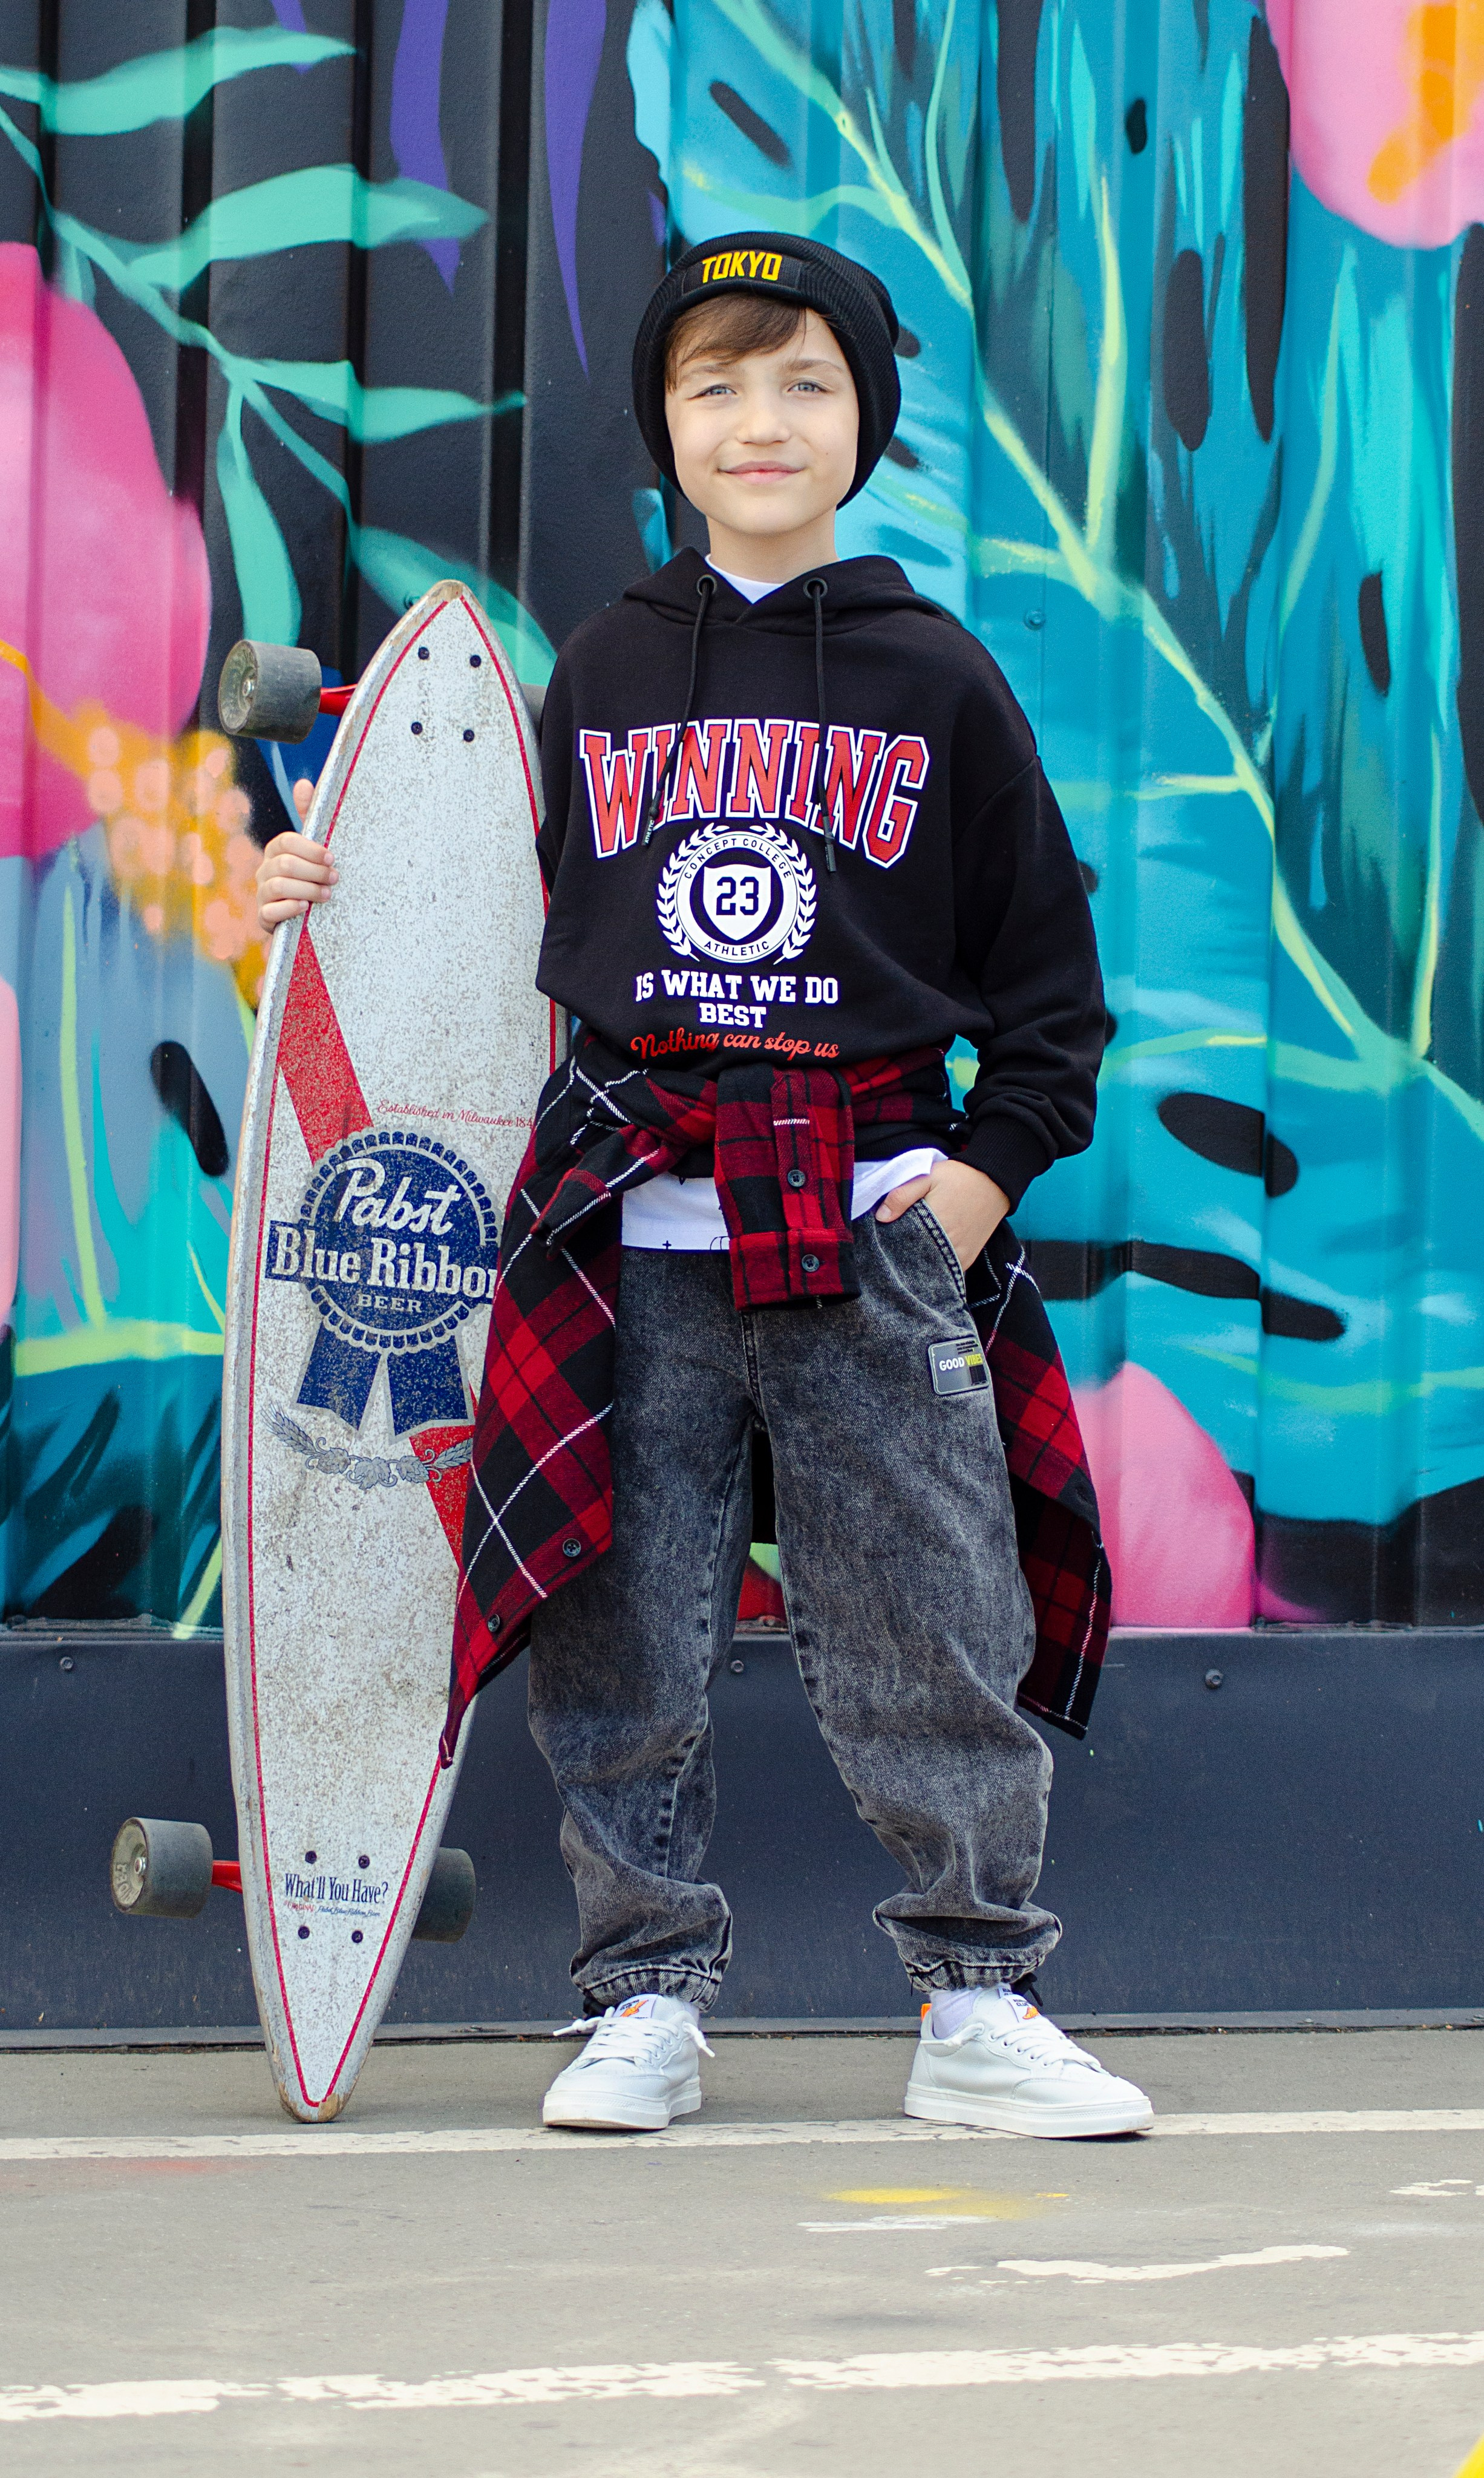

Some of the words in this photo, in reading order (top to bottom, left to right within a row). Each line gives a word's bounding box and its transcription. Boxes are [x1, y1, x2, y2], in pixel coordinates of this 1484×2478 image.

[702, 250, 782, 284] TOKYO
[580, 718, 930, 868] WINNING
[684, 838, 737, 879] CONCEPT
[743, 838, 791, 878] COLLEGE
[716, 876, 759, 916] 23
[704, 941, 770, 956] ATHLETIC
[635, 972, 654, 1002] IS
[661, 969, 742, 1000] WHAT
[750, 975, 797, 1002] WE
[805, 976, 838, 1004] DO
[699, 1002, 767, 1028] BEST
[630, 1027, 720, 1059] Nothing
[723, 1033, 761, 1048] can
[764, 1031, 812, 1061] stop
[814, 1042, 840, 1059] us
[378, 1099, 440, 1119] Established
[442, 1110, 454, 1119] in
[452, 1109, 513, 1127] Milwaukee
[336, 1157, 463, 1236] Pabst
[272, 1226, 362, 1283] Blue
[358, 1292, 423, 1314] BEER
[940, 1358, 964, 1371] GOOD
[285, 1873, 326, 1900] What'll
[329, 1877, 350, 1902] You
[352, 1878, 389, 1904] Have?
